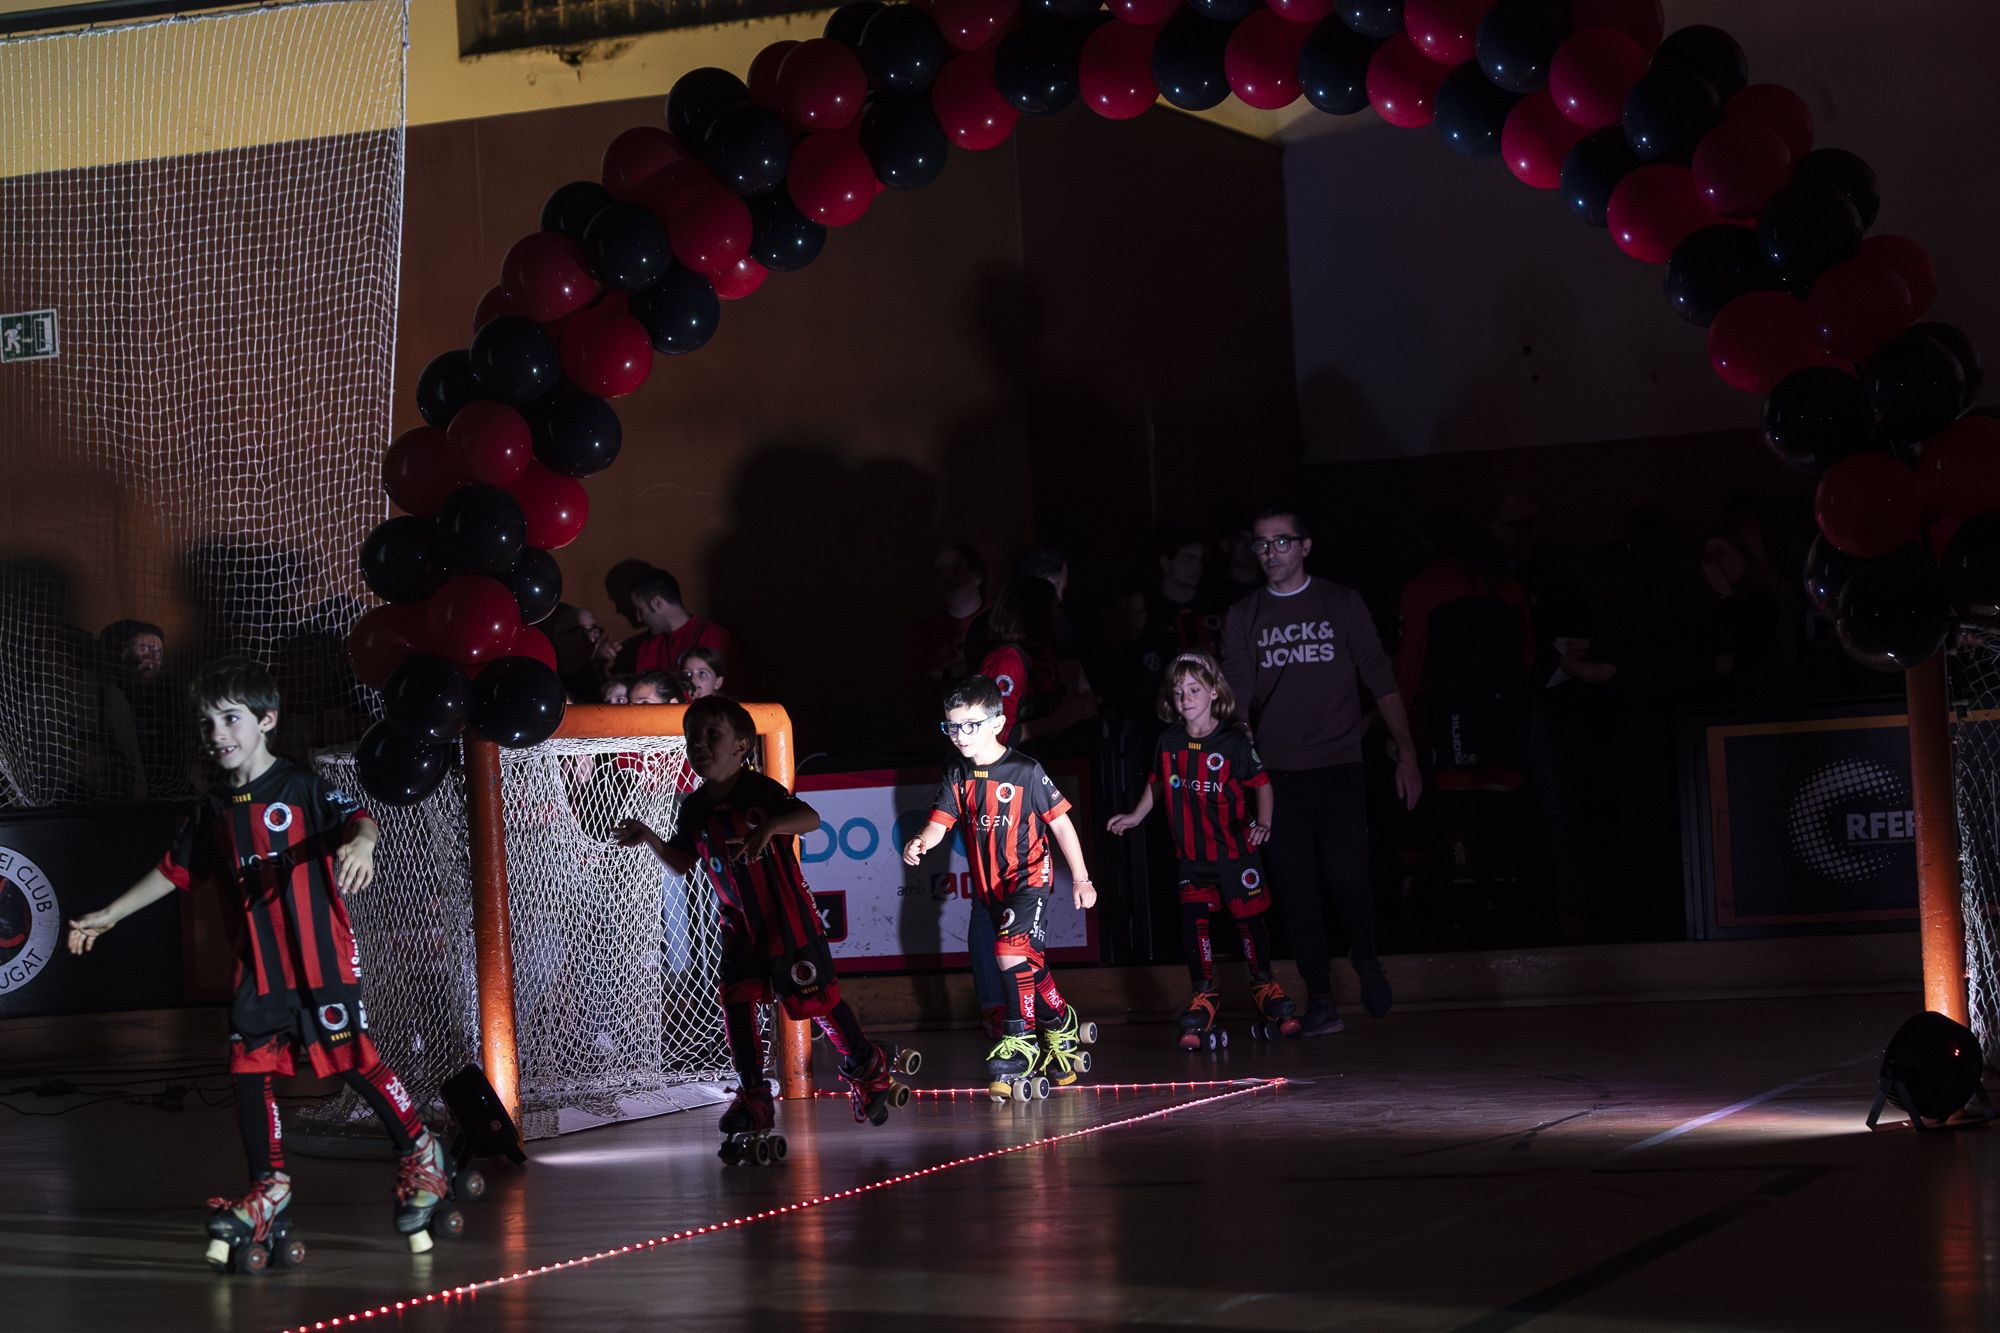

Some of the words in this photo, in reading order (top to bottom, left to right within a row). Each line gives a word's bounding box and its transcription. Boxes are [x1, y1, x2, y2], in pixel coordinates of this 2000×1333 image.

[1257, 620, 1335, 647] JACK&
[1261, 643, 1335, 668] JONES
[16, 866, 53, 913] CLUB
[0, 948, 43, 989] UGAT
